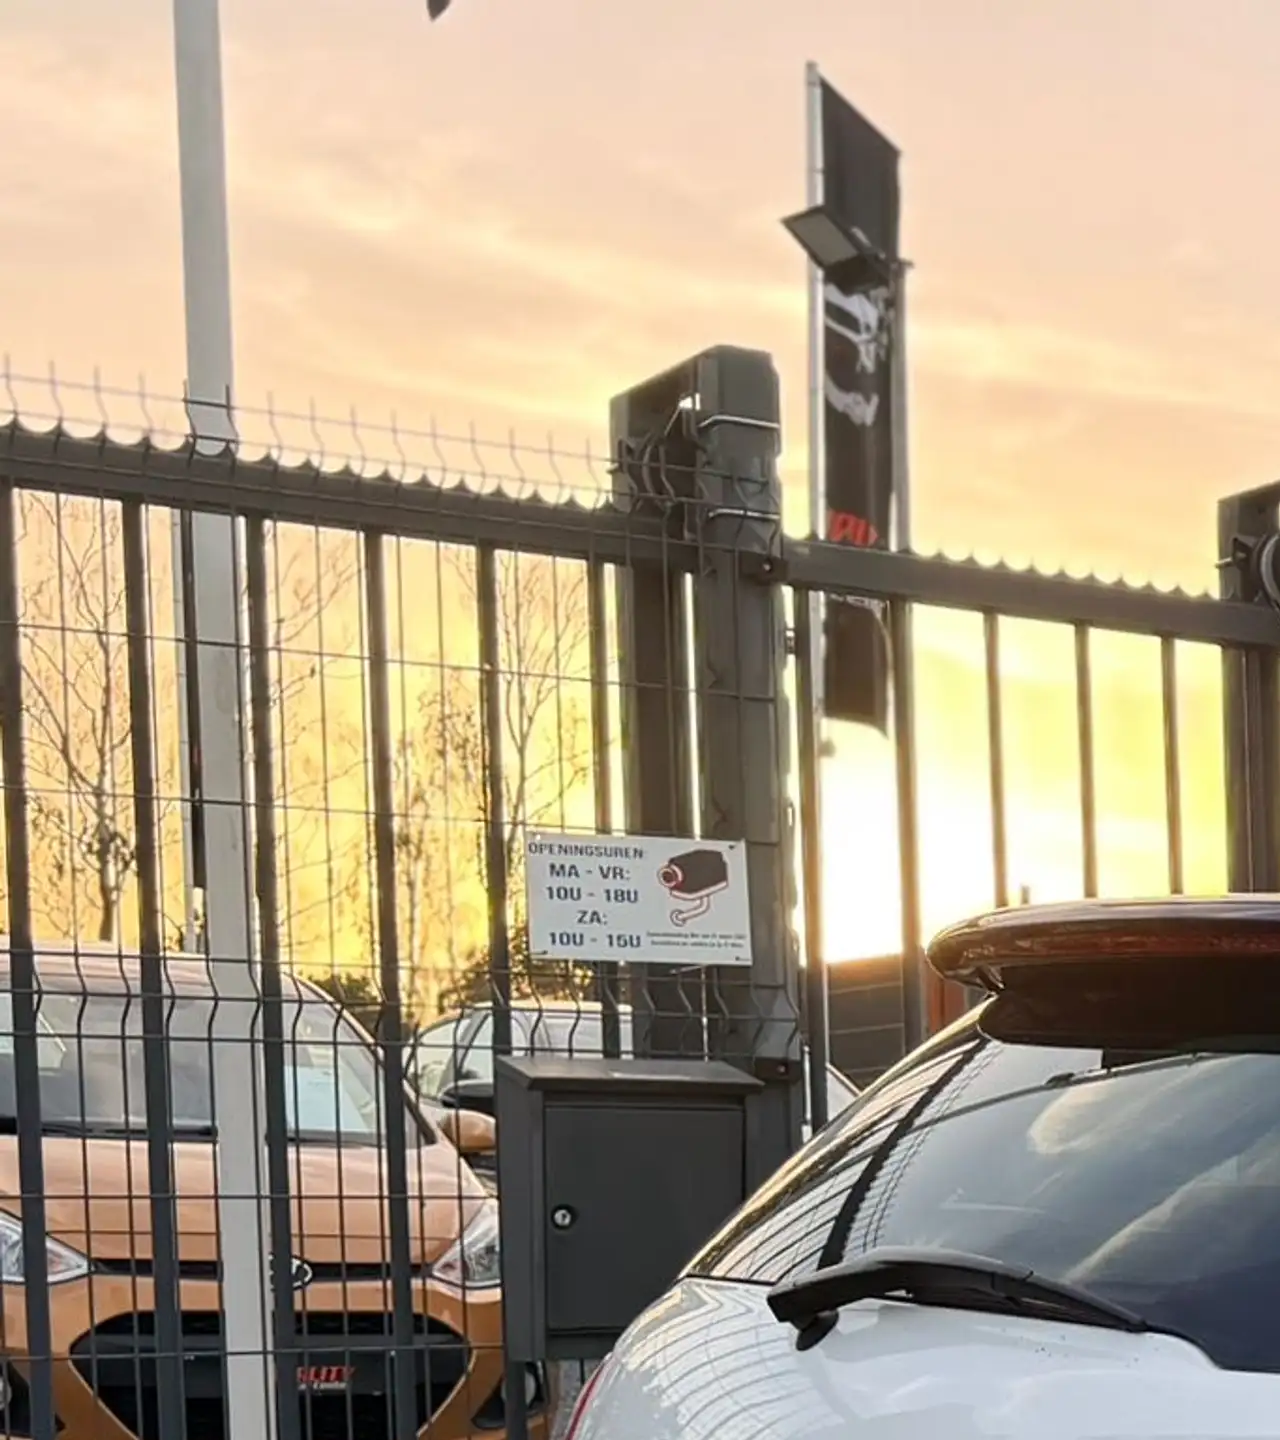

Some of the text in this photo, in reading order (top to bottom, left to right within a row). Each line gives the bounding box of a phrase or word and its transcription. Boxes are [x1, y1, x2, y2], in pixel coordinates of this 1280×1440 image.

[549, 863, 580, 878] MA
[598, 865, 631, 881] VR:
[546, 886, 582, 901] 10U
[605, 888, 639, 904] 18U
[576, 910, 608, 925] ZA:
[549, 932, 584, 947] 10U
